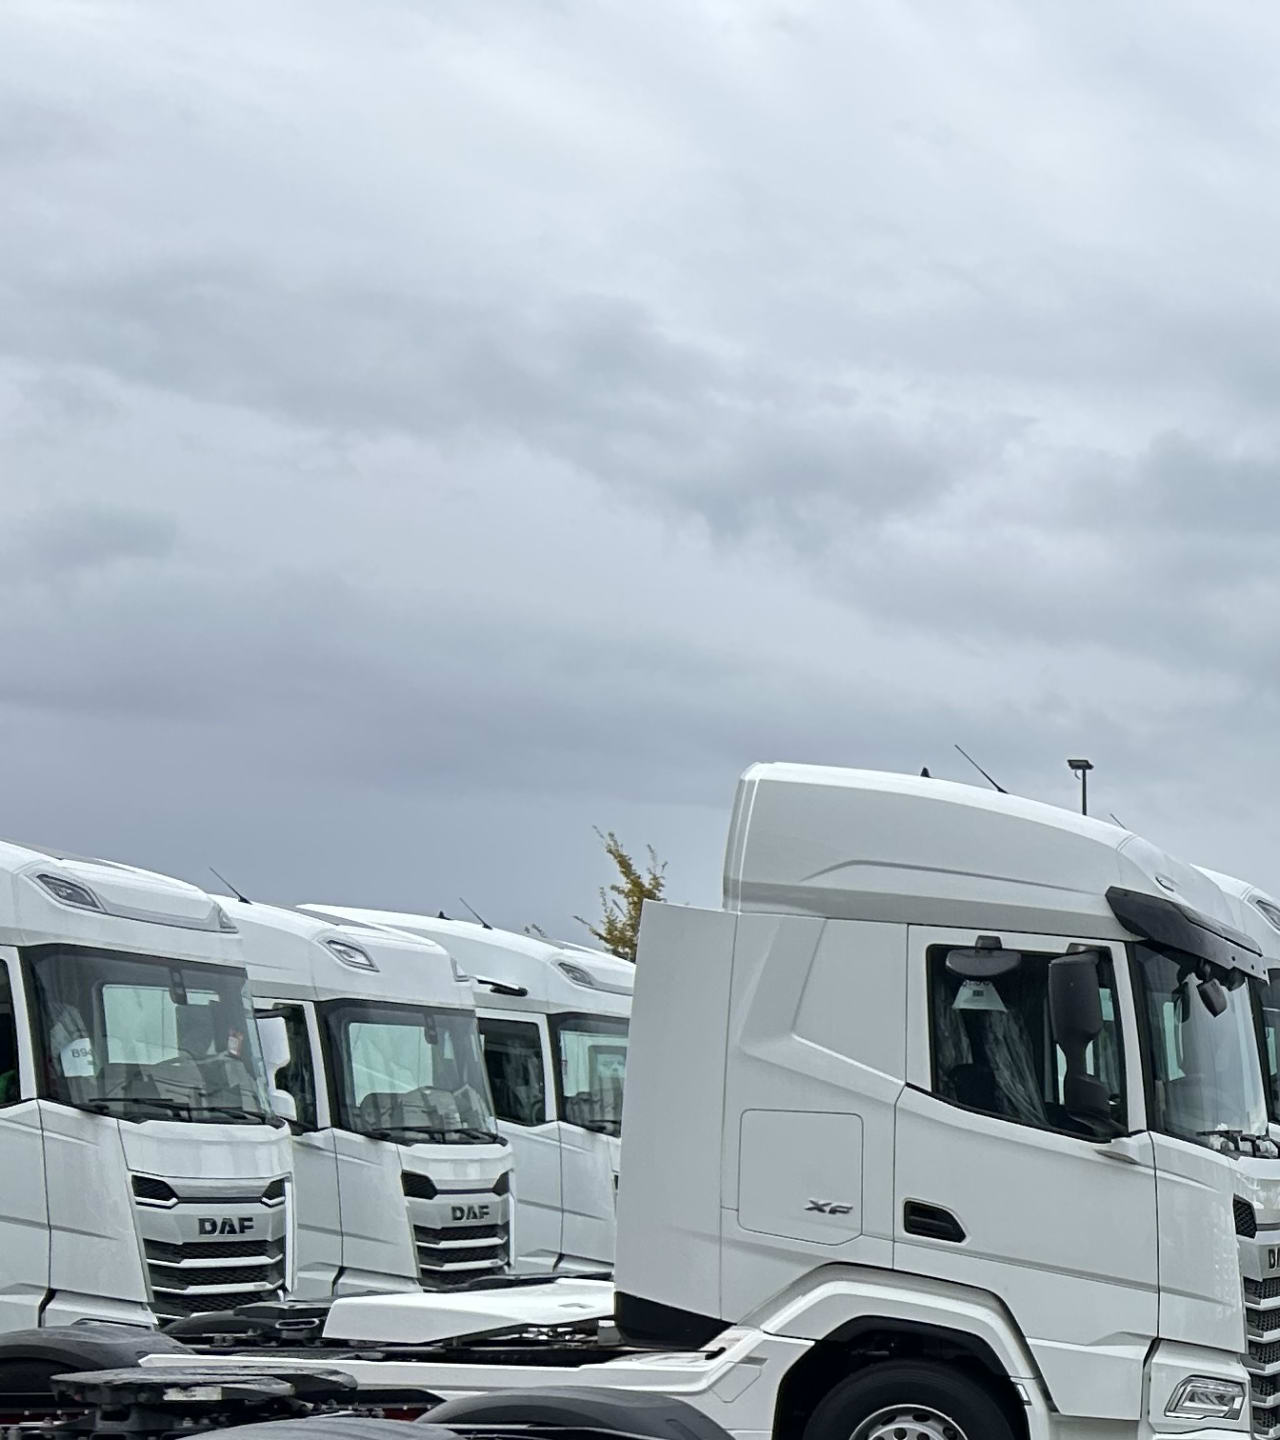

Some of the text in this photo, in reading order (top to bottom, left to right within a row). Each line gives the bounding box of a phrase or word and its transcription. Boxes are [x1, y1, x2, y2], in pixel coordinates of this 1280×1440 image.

[451, 1205, 490, 1221] DAF
[804, 1199, 853, 1214] XF
[198, 1217, 254, 1235] DAF
